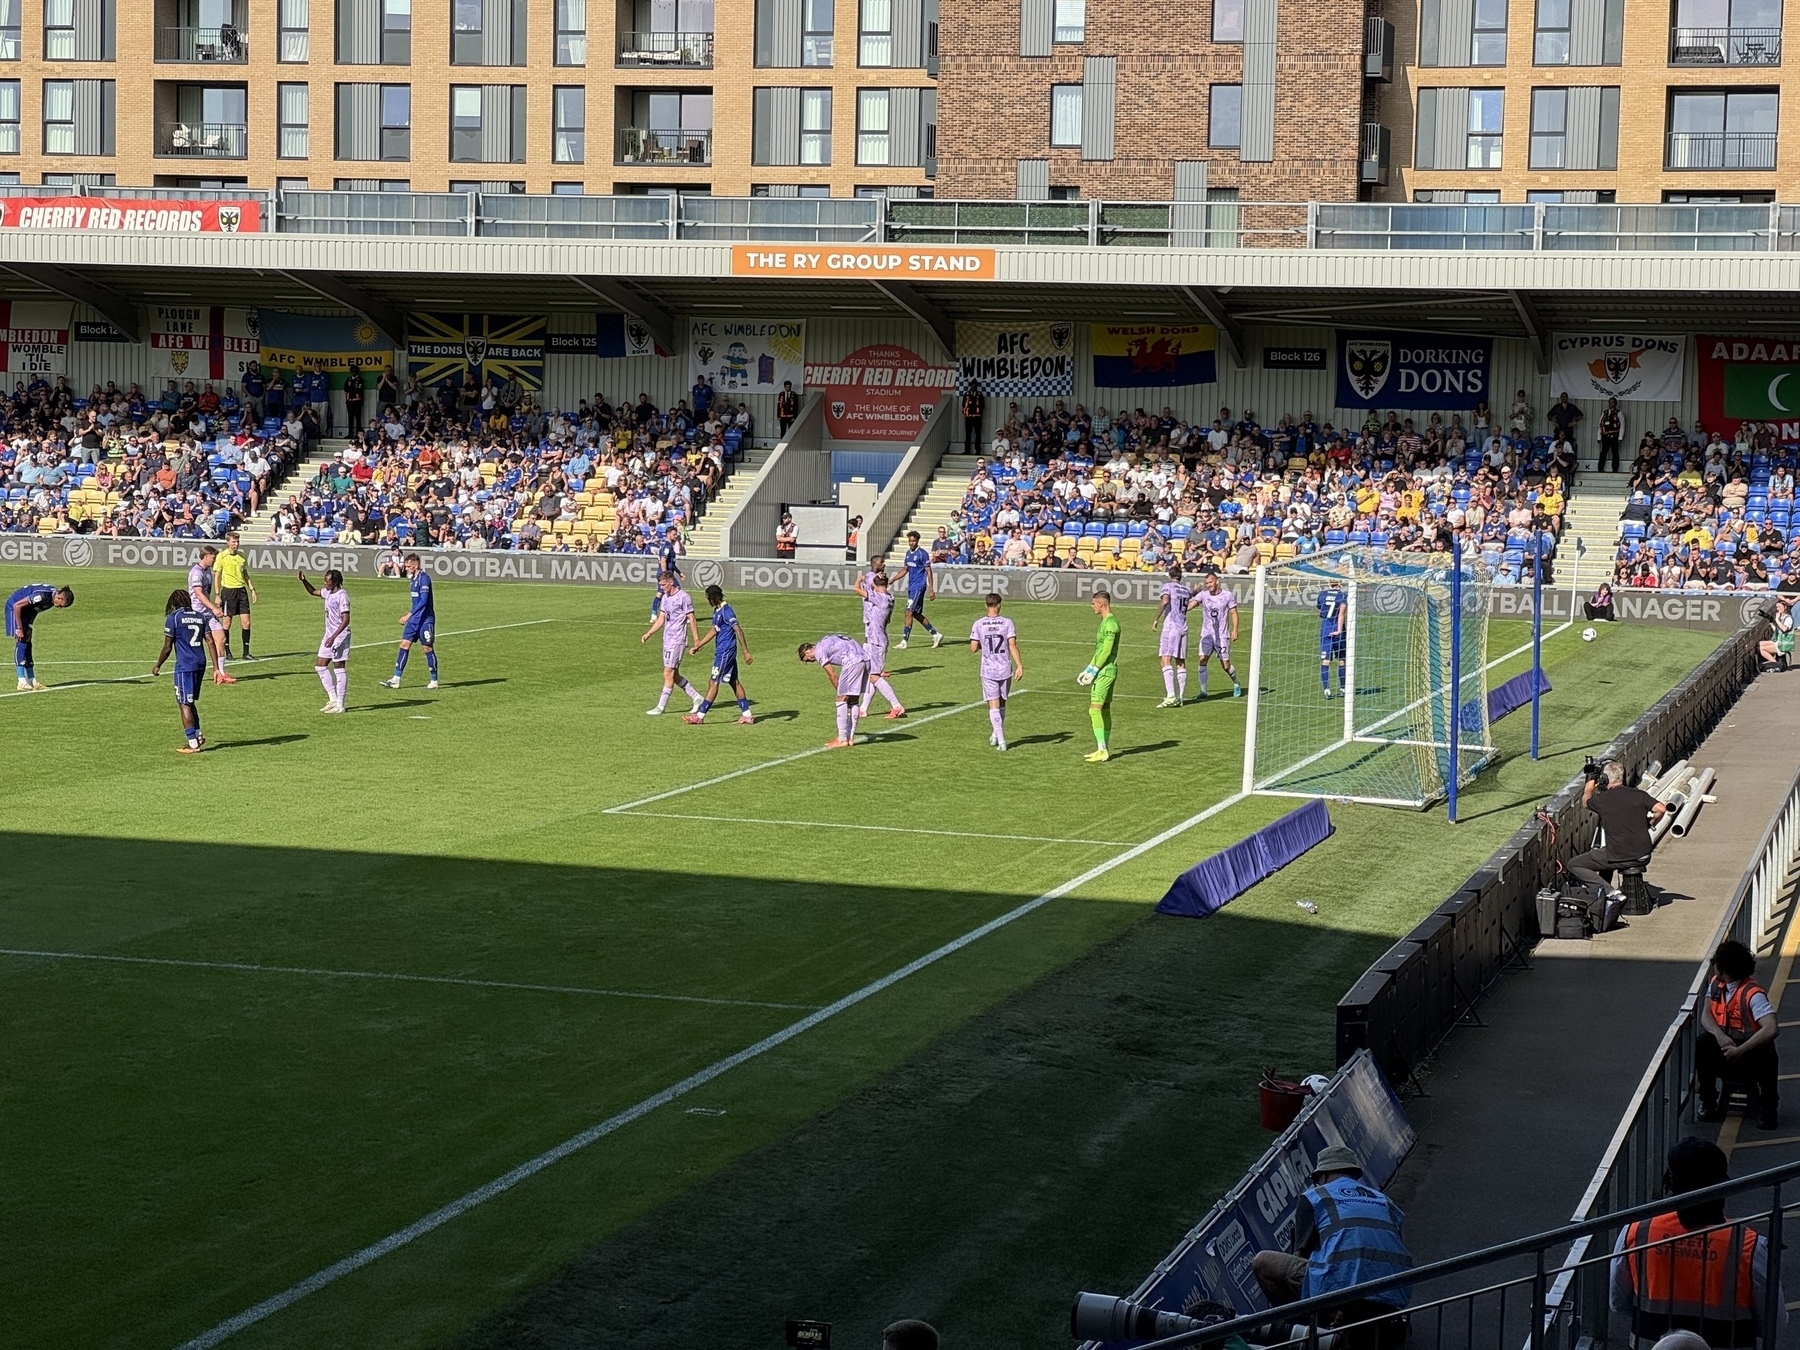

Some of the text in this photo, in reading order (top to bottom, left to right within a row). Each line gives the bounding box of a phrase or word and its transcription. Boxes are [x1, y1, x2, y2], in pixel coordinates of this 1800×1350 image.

[20, 206, 203, 232] CHERRY RED RECORDS
[746, 252, 981, 272] THE RY GROUP STAND
[158, 307, 200, 320] PLOUGH
[80, 326, 107, 334] Block
[166, 321, 194, 333] LANE
[692, 322, 800, 338] AFC WIMBLEDON
[1106, 324, 1199, 337] WELSH DONS
[158, 334, 184, 348] AFC
[552, 337, 597, 348] Block 125
[997, 331, 1031, 355] AFC
[1558, 335, 1679, 354] CYPRUS DONS
[12, 344, 64, 354] WOMBLE
[410, 344, 464, 355] THE DONS
[488, 346, 542, 358] ARE BACK
[868, 350, 900, 358] THANKS
[268, 353, 383, 368] AFC WIMBLEDON
[1270, 351, 1320, 362] Block 126
[1398, 349, 1484, 364] DORKING
[22, 362, 52, 371] I DIE
[961, 355, 1066, 380] WIMBLEDON
[804, 366, 862, 386] CHERRY
[862, 367, 894, 386] RED
[1398, 368, 1483, 394] DONS
[866, 388, 901, 396] STADIUM
[854, 404, 911, 413] THE HOME OF
[244, 549, 359, 572] MANAGER
[420, 554, 658, 582] FOOTBALL MANAGE
[1177, 596, 1189, 615] 15
[1325, 602, 1336, 618] 7
[188, 624, 201, 647] 2
[424, 630, 430, 639] 8
[985, 634, 1005, 654] 12
[665, 651, 672, 659] 11
[711, 666, 719, 676] 16
